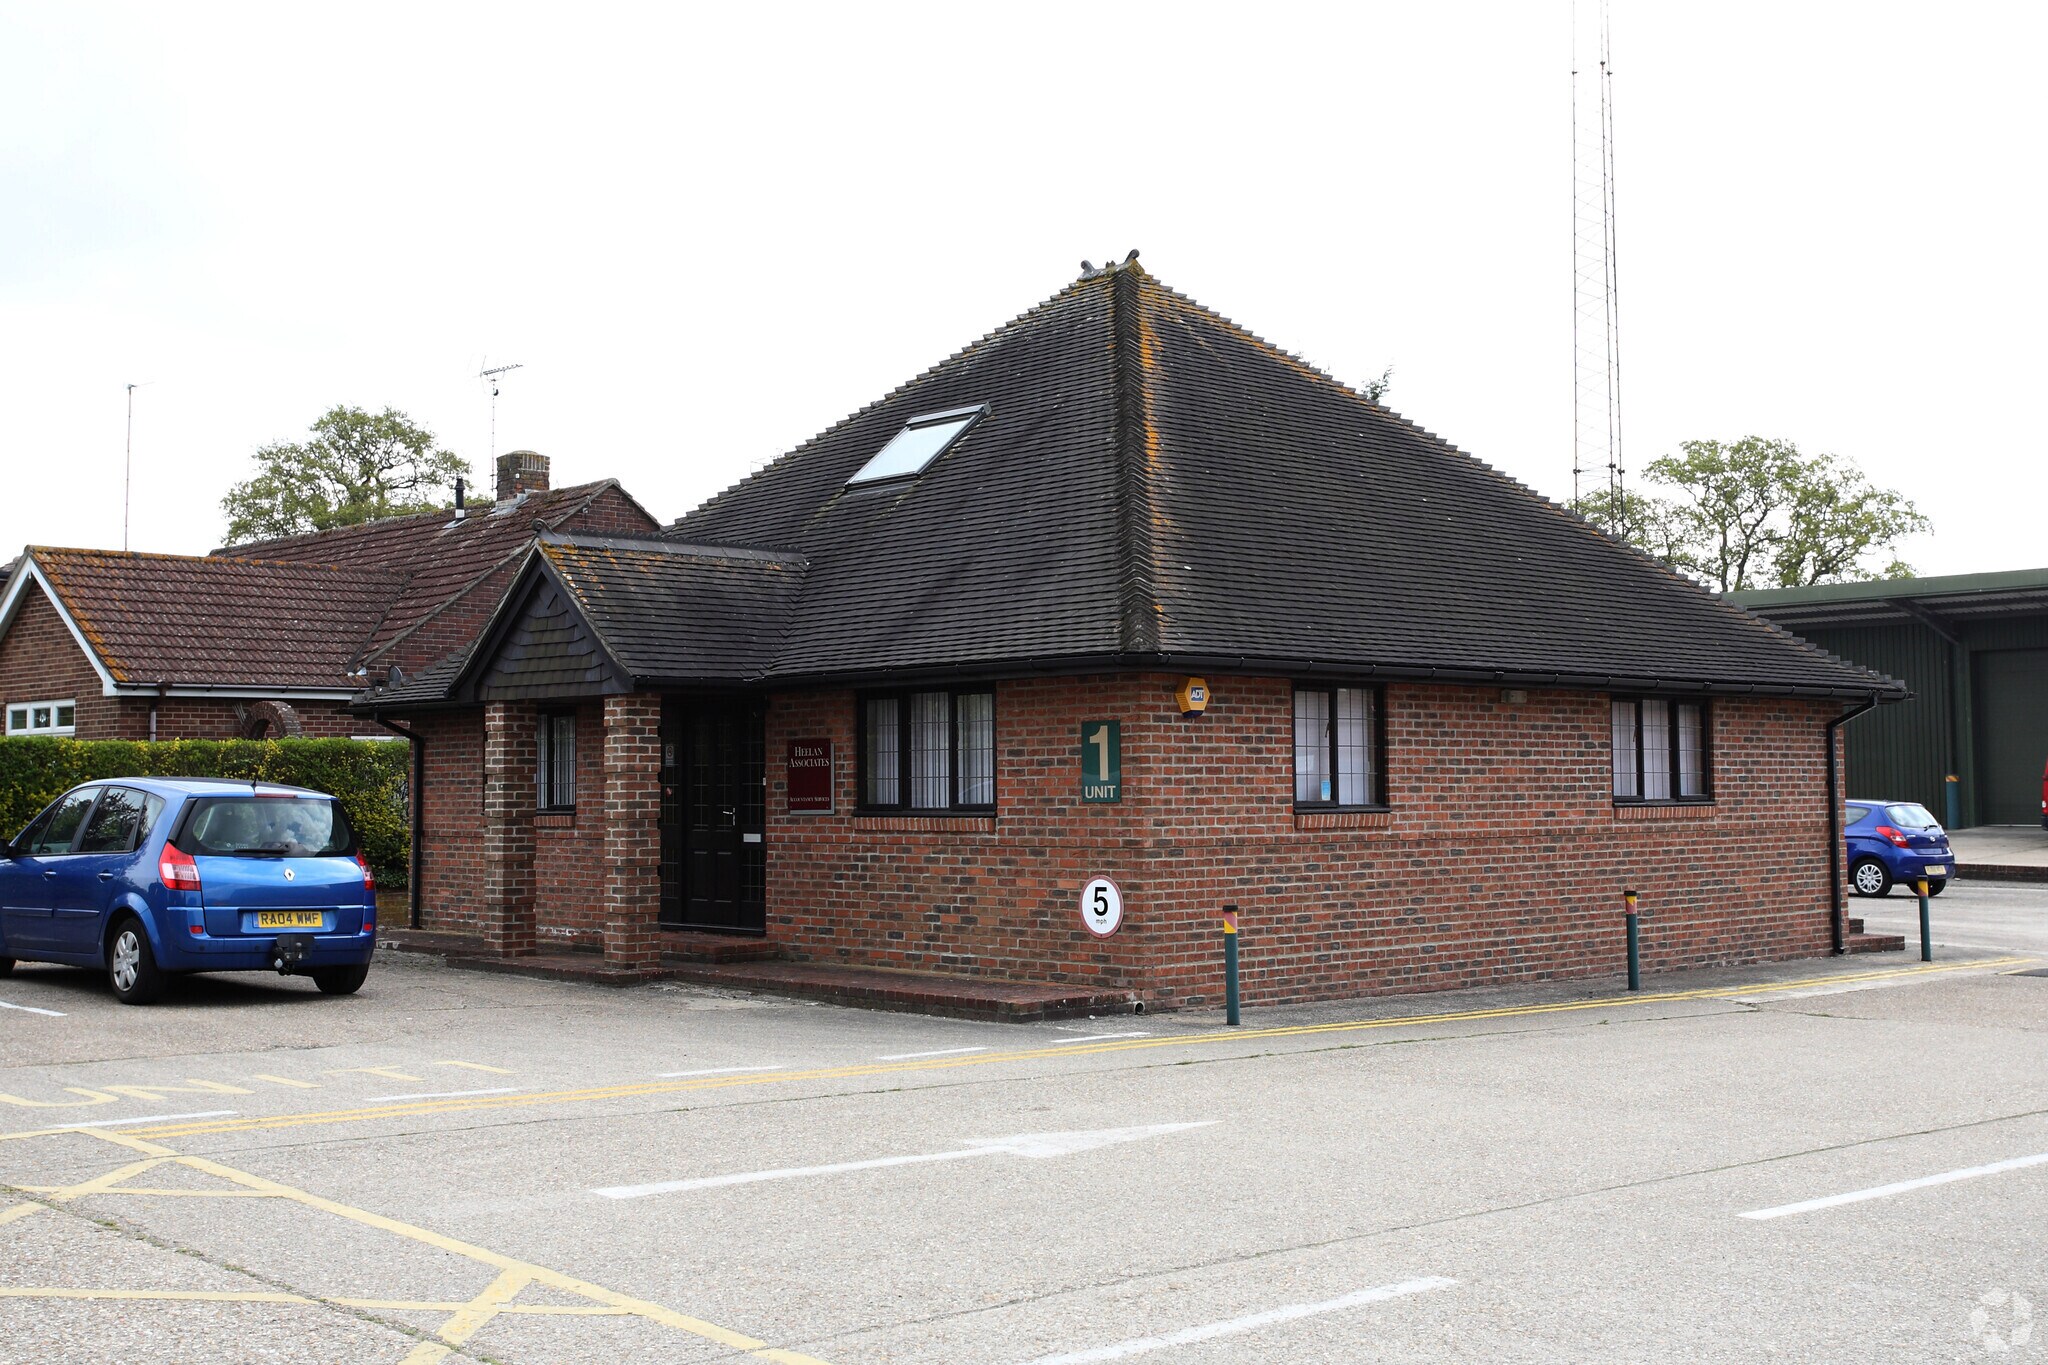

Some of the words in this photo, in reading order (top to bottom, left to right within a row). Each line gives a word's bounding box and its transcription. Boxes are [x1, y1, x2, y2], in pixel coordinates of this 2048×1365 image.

[1191, 689, 1204, 699] ADT
[795, 747, 822, 756] HEELAN
[1089, 725, 1109, 781] 1
[789, 759, 829, 767] ASSOCIATES
[1085, 785, 1116, 798] UNIT
[1093, 886, 1109, 917] 5
[260, 912, 293, 925] RA04
[296, 912, 319, 924] WMF
